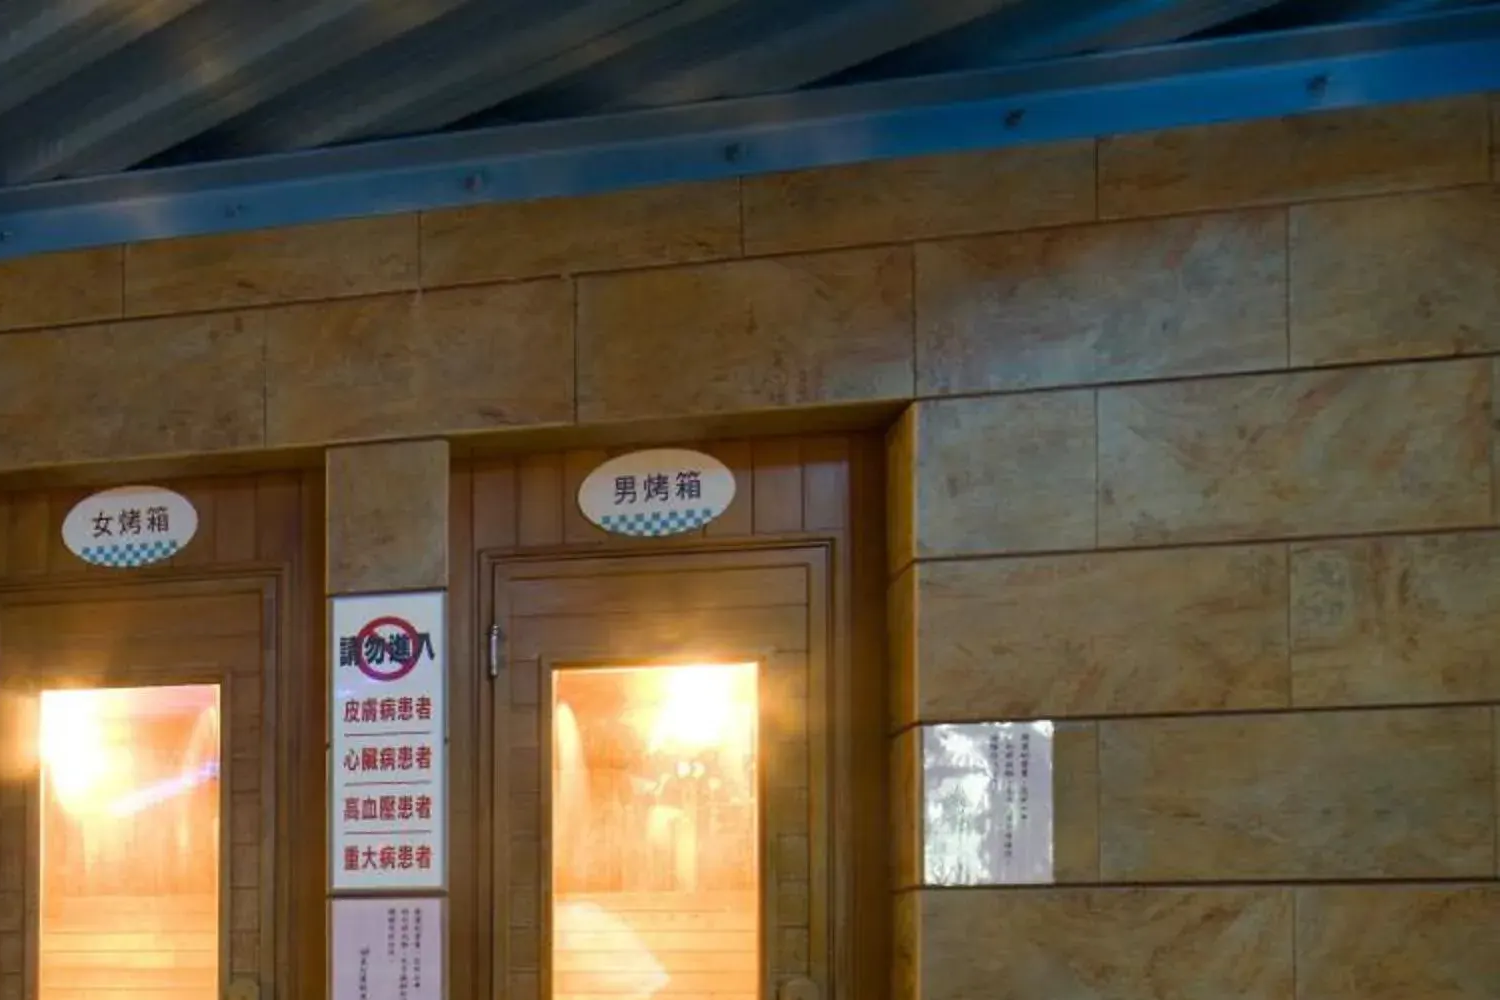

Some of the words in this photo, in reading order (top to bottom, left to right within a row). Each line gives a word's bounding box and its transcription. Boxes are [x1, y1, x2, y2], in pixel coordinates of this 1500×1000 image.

[613, 469, 702, 506] 男烤箱
[92, 505, 170, 539] 女烤箱
[339, 631, 435, 668] 請勿進入
[343, 695, 432, 723] 皮膚病患者
[343, 795, 432, 821] 高血壓患者
[343, 845, 432, 871] 重大病患者
